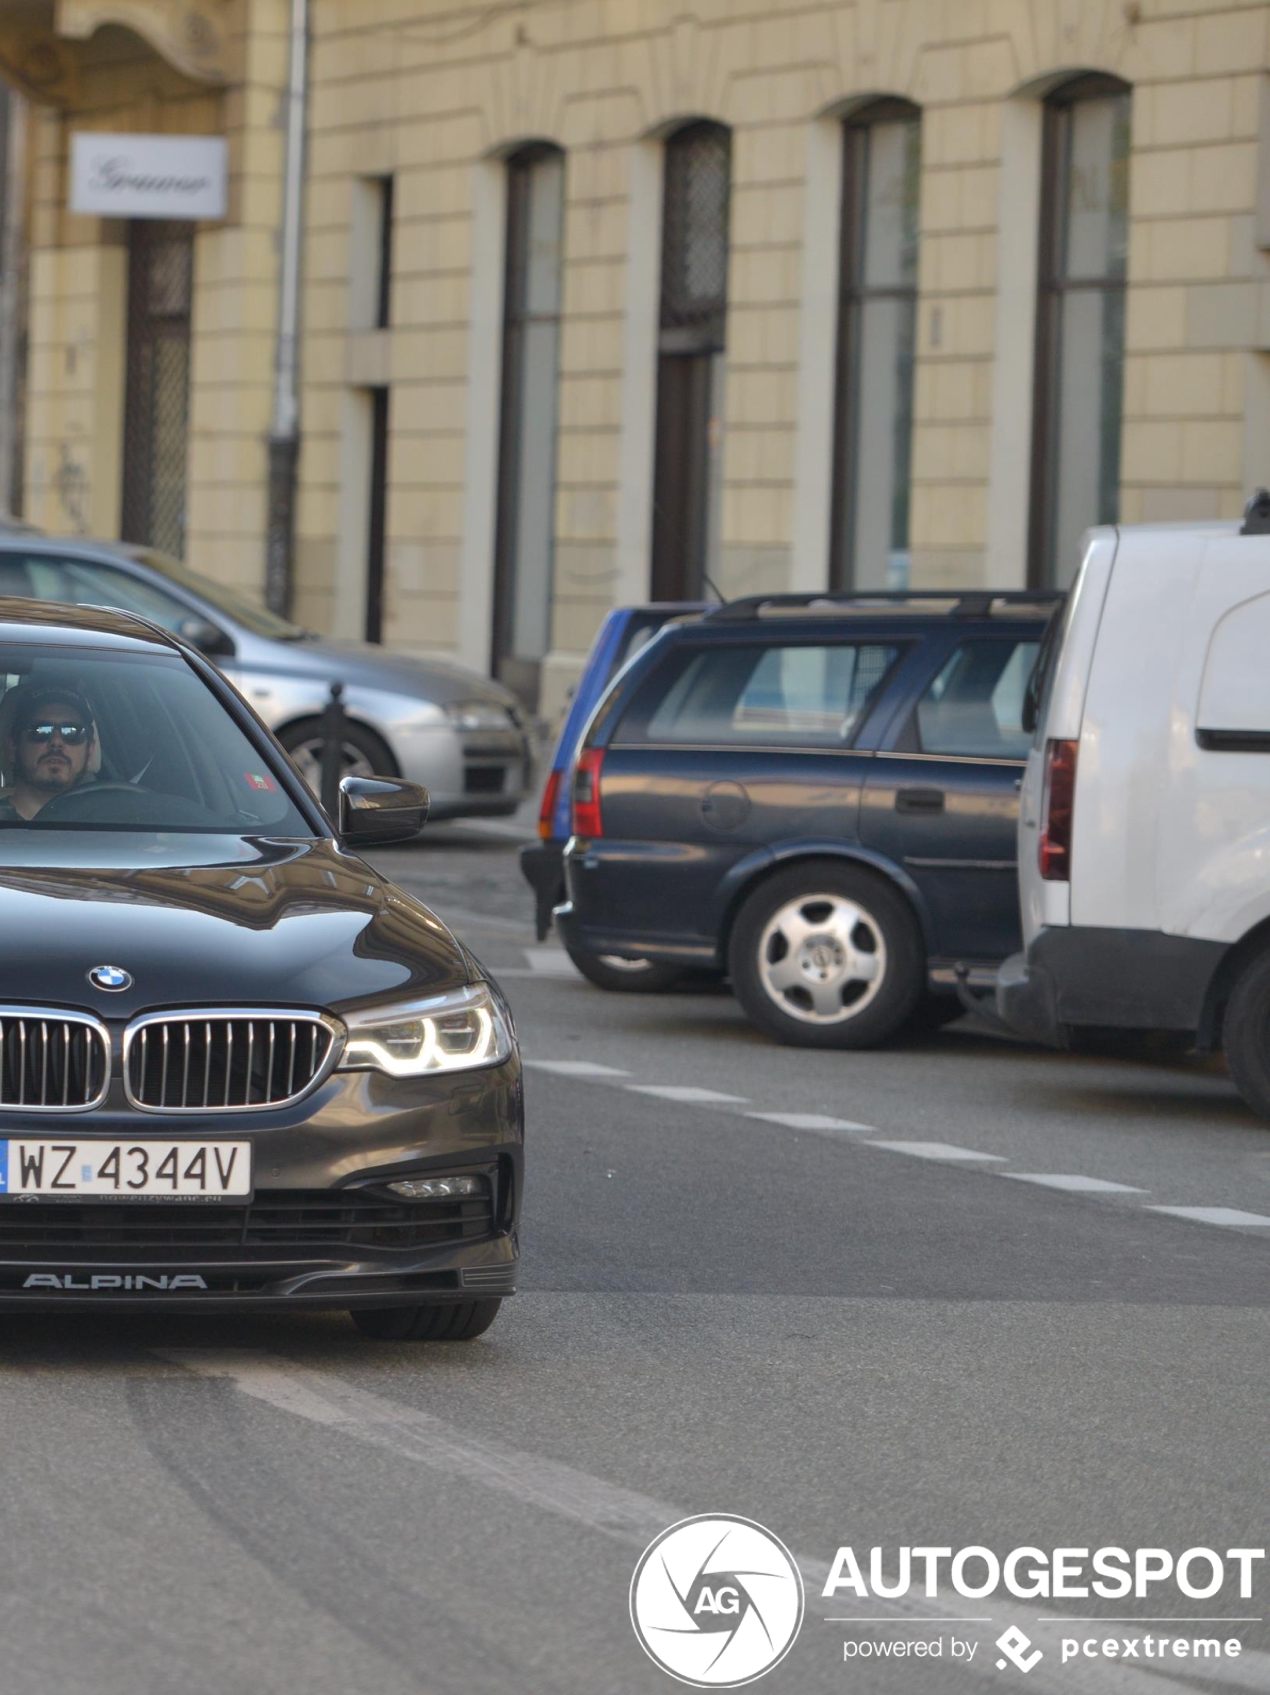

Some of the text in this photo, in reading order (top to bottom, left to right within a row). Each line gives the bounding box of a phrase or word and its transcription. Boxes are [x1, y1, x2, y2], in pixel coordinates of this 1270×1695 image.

[19, 1145, 238, 1190] WZ 4344V
[22, 1273, 208, 1290] ALPINA
